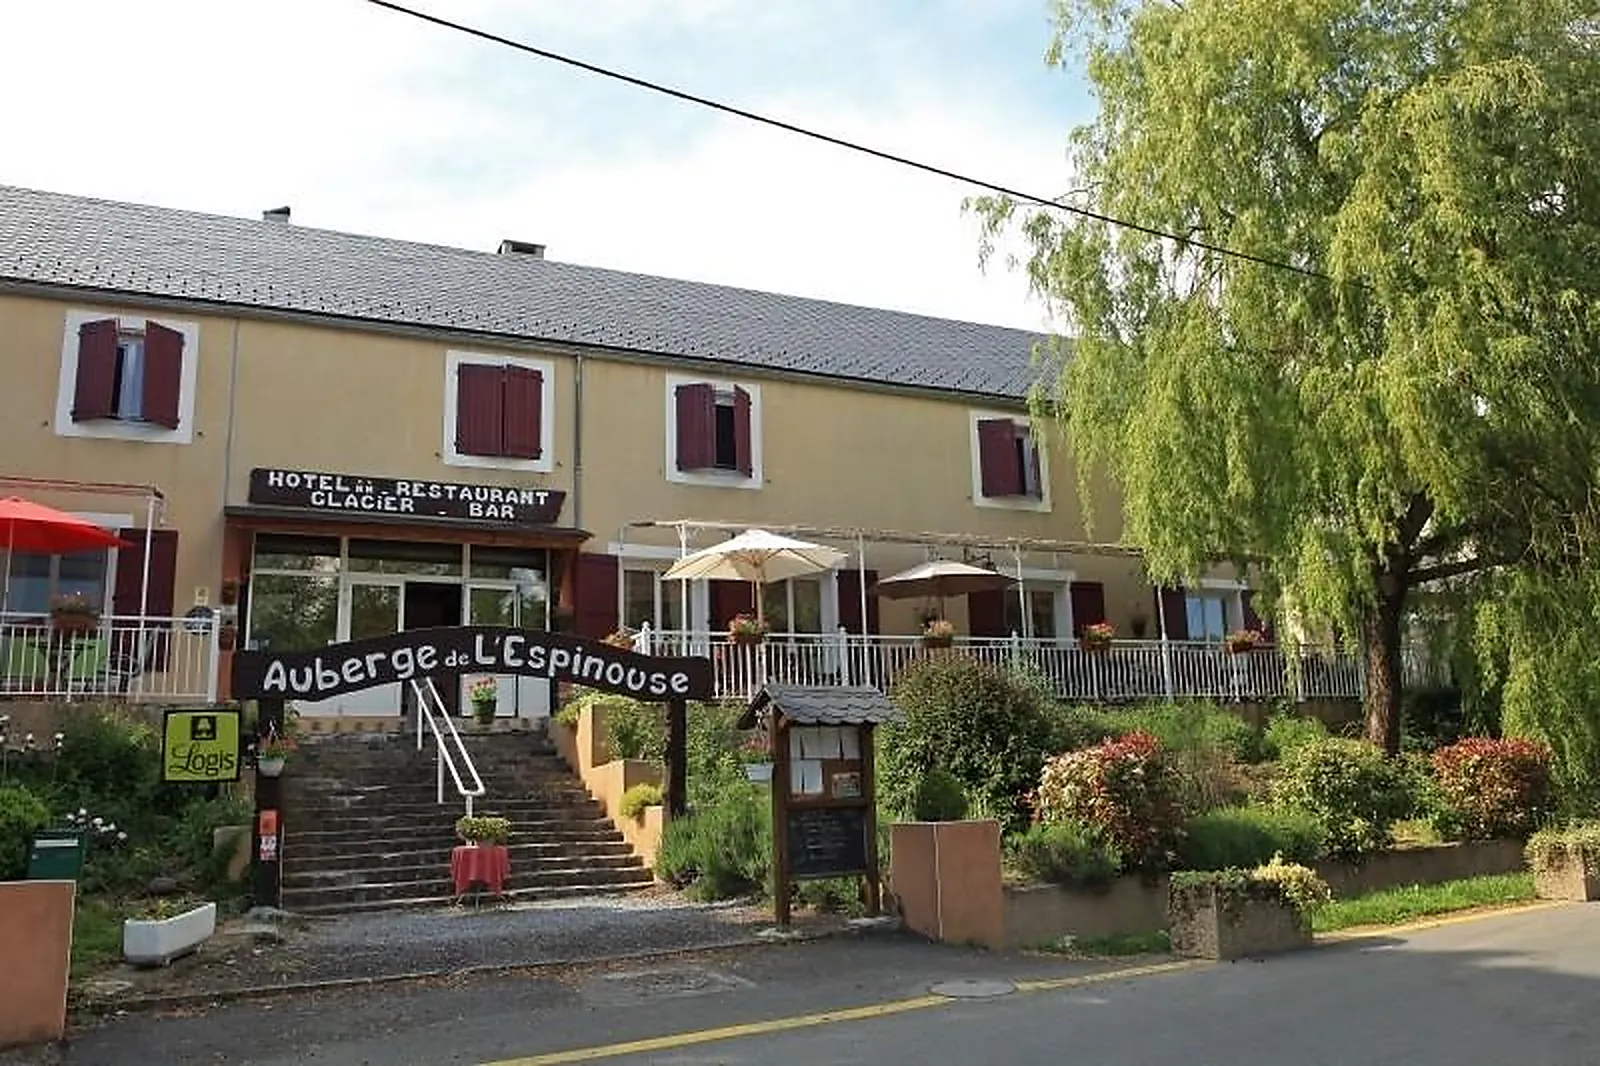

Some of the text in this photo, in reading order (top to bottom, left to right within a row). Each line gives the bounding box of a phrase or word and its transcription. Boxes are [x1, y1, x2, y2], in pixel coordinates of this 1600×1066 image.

[268, 471, 351, 492] HOTEL
[396, 481, 550, 506] RESTAURANT
[469, 502, 516, 519] BAR
[262, 634, 689, 695] Auberge de L'Espinouse
[169, 742, 235, 776] Logis
